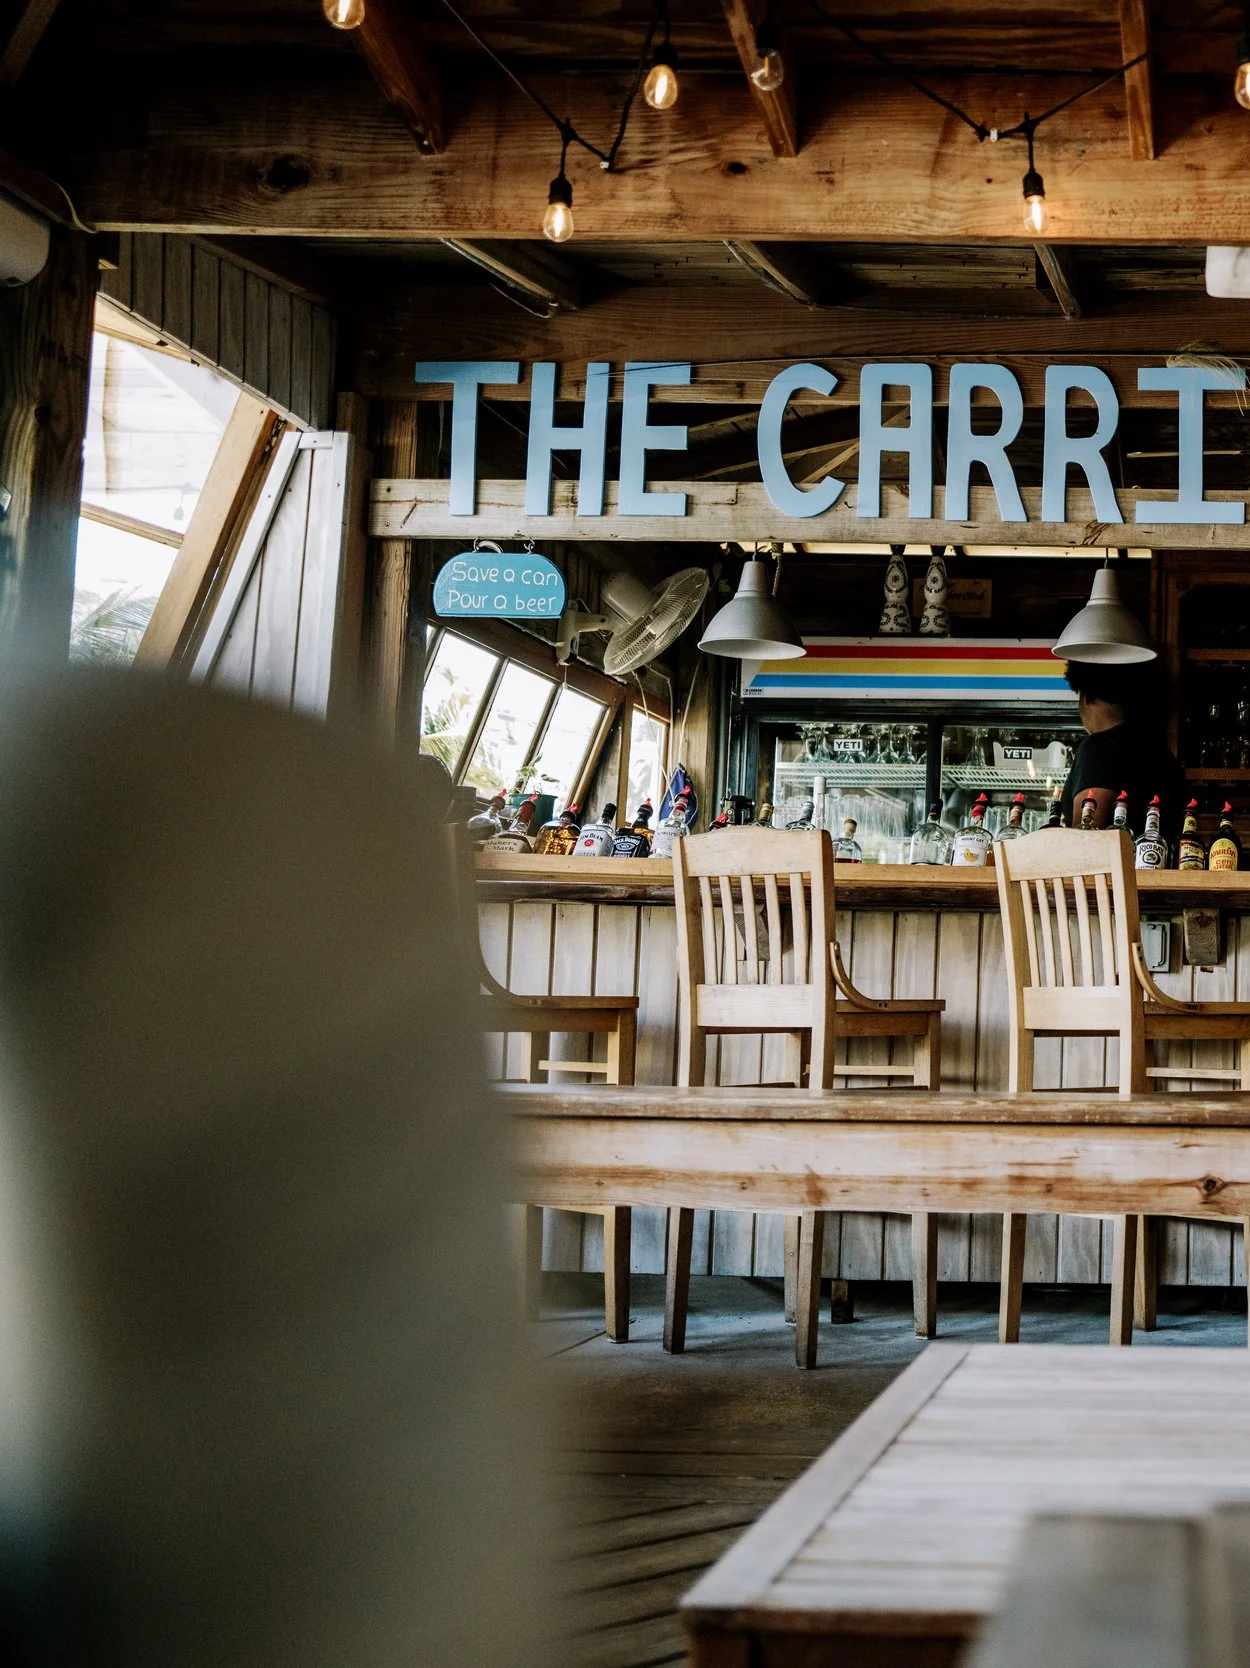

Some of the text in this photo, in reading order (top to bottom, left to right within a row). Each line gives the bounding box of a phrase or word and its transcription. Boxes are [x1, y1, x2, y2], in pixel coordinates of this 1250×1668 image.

[415, 361, 692, 516] THE
[451, 561, 558, 586] Save a can
[447, 589, 557, 612] Pour a beer
[835, 741, 861, 749] YETI
[1005, 749, 1031, 759] YETI
